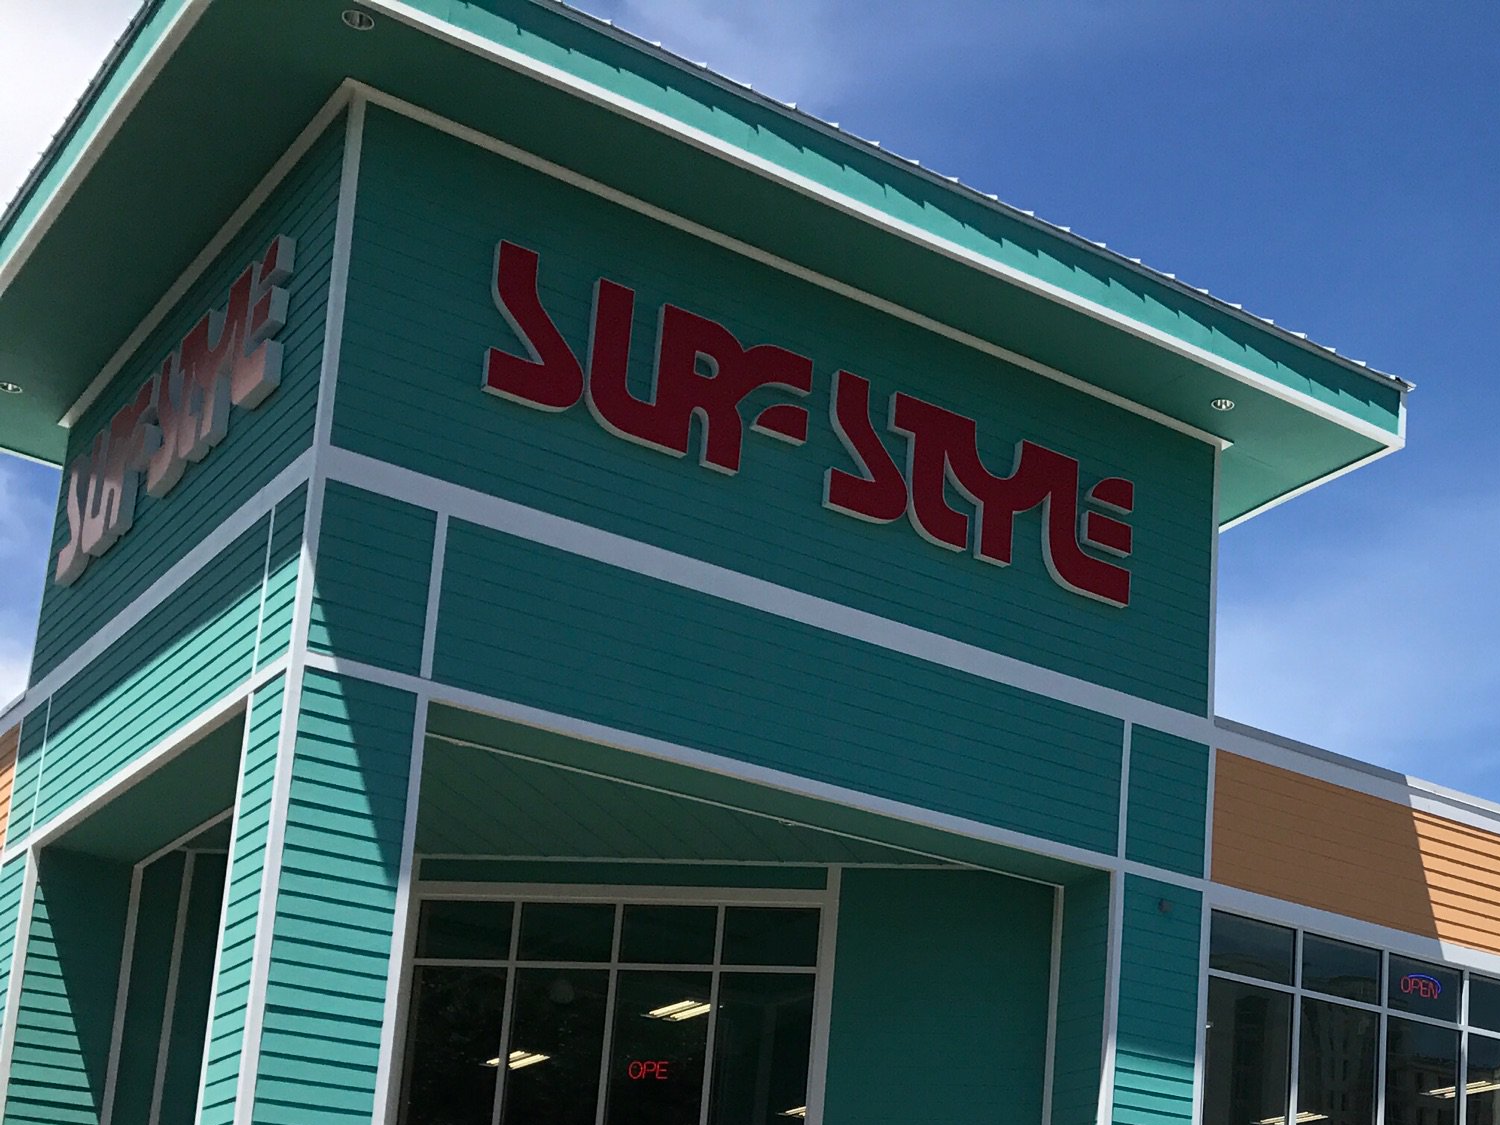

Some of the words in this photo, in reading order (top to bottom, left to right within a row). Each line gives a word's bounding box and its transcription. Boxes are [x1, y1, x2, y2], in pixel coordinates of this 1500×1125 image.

[480, 238, 812, 475] SURF
[822, 369, 1135, 608] STYLE
[1400, 976, 1438, 1000] OPEN
